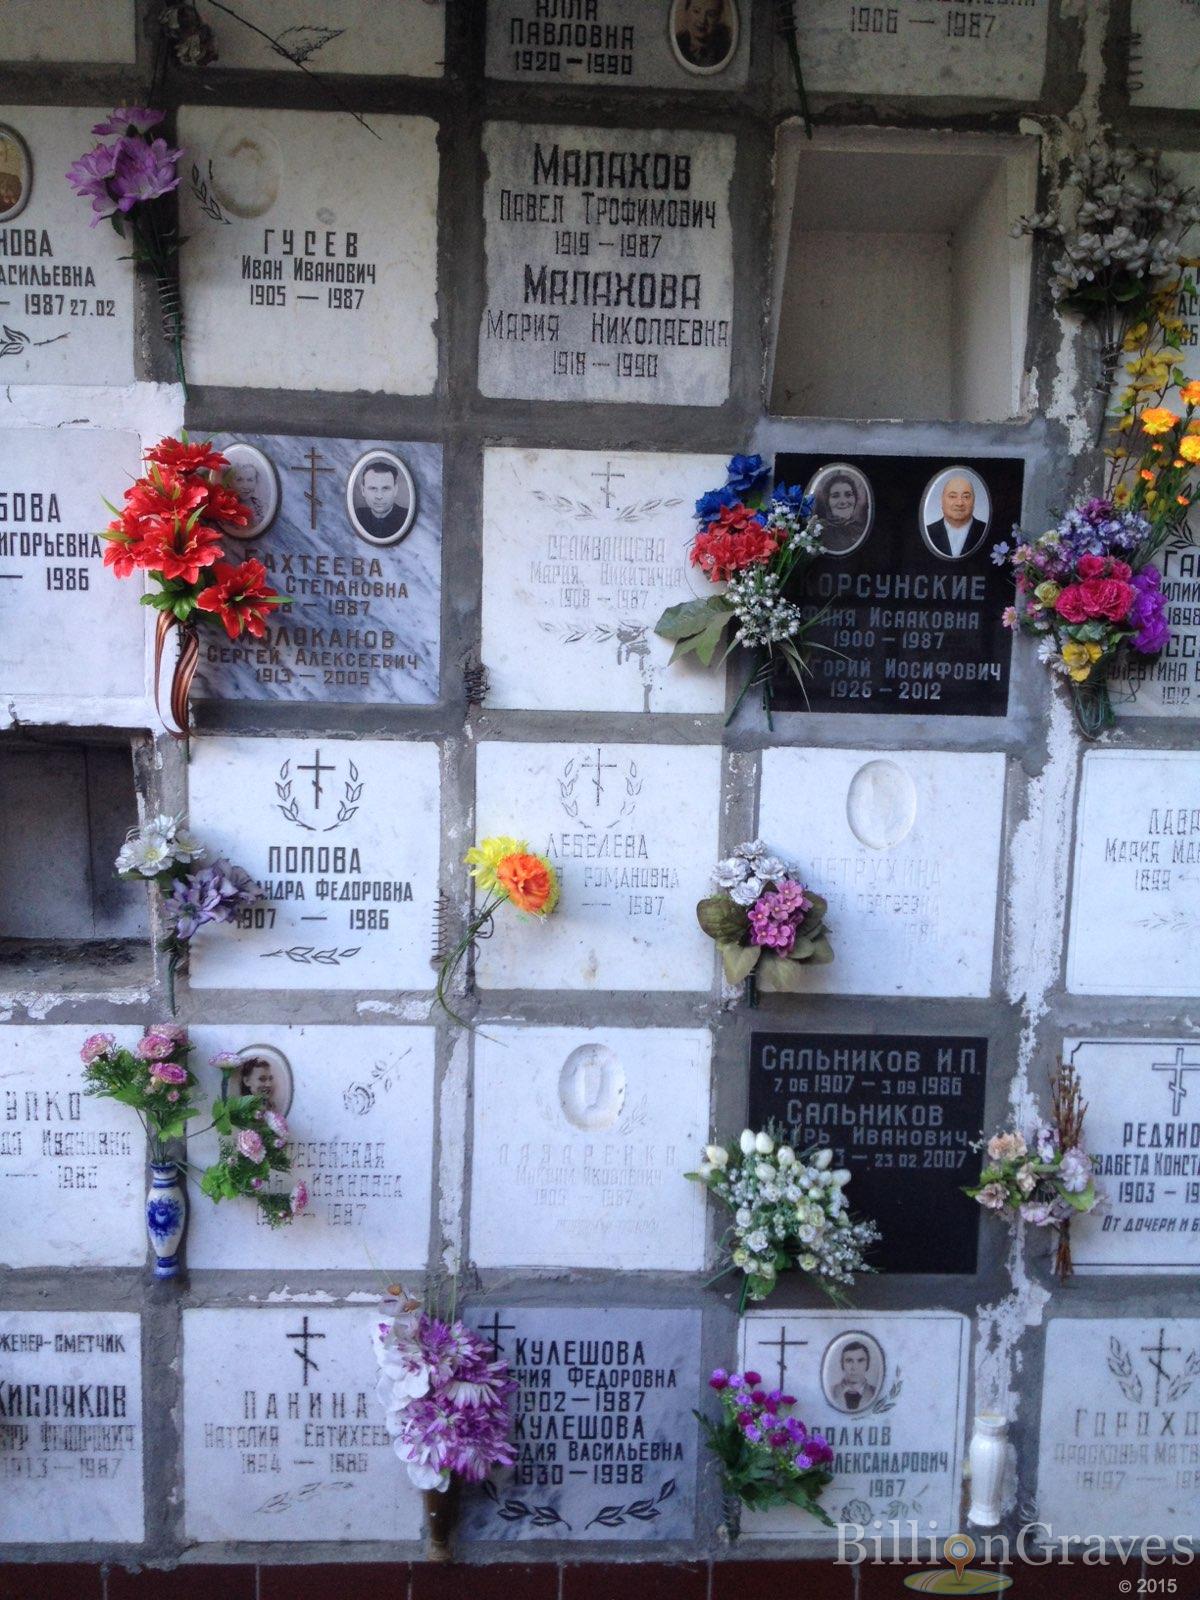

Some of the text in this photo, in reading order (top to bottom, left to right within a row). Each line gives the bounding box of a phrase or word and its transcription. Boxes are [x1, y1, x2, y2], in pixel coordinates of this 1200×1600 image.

[851, 6, 898, 34] 1906
[510, 18, 634, 49] ПАВЛОВНА
[515, 51, 561, 71] 1920
[587, 53, 633, 75] 1990
[533, 143, 691, 191] МАЛАХОВ
[500, 189, 716, 229] ПАВЕЛ ТРОФИМОВИЧ
[264, 229, 358, 258] ГУСЕВ
[555, 231, 589, 255] 1919
[620, 234, 662, 258] 1987
[242, 255, 376, 284] ИВАН ИВАНОВИЧ
[250, 284, 286, 306] 1905
[328, 287, 365, 310] 1987
[524, 264, 701, 310] МАЛАХОВА
[25, 294, 116, 317] 1987 27.02
[487, 310, 729, 347] МАРИЯ НИКОЛАЕВНА
[553, 351, 586, 375] 1918
[617, 353, 658, 378] 1990
[245, 549, 383, 577] АХТЕЕВА
[46, 567, 89, 590] 1986
[285, 575, 409, 598] СТЕПАНОВНА
[328, 600, 371, 616] 1987
[870, 607, 979, 630] ИСААКОВНА
[833, 631, 876, 648] 1900
[902, 632, 945, 649] 1987
[207, 644, 418, 670] СЕРГЕЙ АЛЕКСЕЕВИЧ
[885, 658, 1001, 681] ИОСИФОВИЧ
[323, 671, 370, 685] 2005
[899, 682, 941, 700] 2012
[268, 846, 361, 873] ПОПОВА
[315, 879, 413, 902] ФЕДОРОВНА
[350, 909, 389, 930] 1986
[762, 1045, 920, 1070] САЛЬНИКОВ
[787, 1099, 944, 1127] САЛЬНИКОВ
[853, 1126, 967, 1146] ИВАНОВИЧ
[1154, 1153, 1200, 1176] КОНСТ
[1119, 1182, 1155, 1203] 1903
[1102, 1215, 1121, 1232] ОТ
[1123, 1217, 1177, 1232] ДОЧЕРИ
[515, 1338, 646, 1366] КУЛЕШОВА
[568, 1366, 677, 1391] ФЕДОРОВНА
[244, 1390, 369, 1419] ПАНИНА
[516, 1391, 566, 1412] 1902
[595, 1391, 646, 1412] 1987
[514, 1414, 645, 1440] КУЛЕШОВА
[569, 1441, 684, 1462] ВАСИЛЬЕВНА
[513, 1464, 564, 1485] 1930
[594, 1464, 643, 1485] 1998
